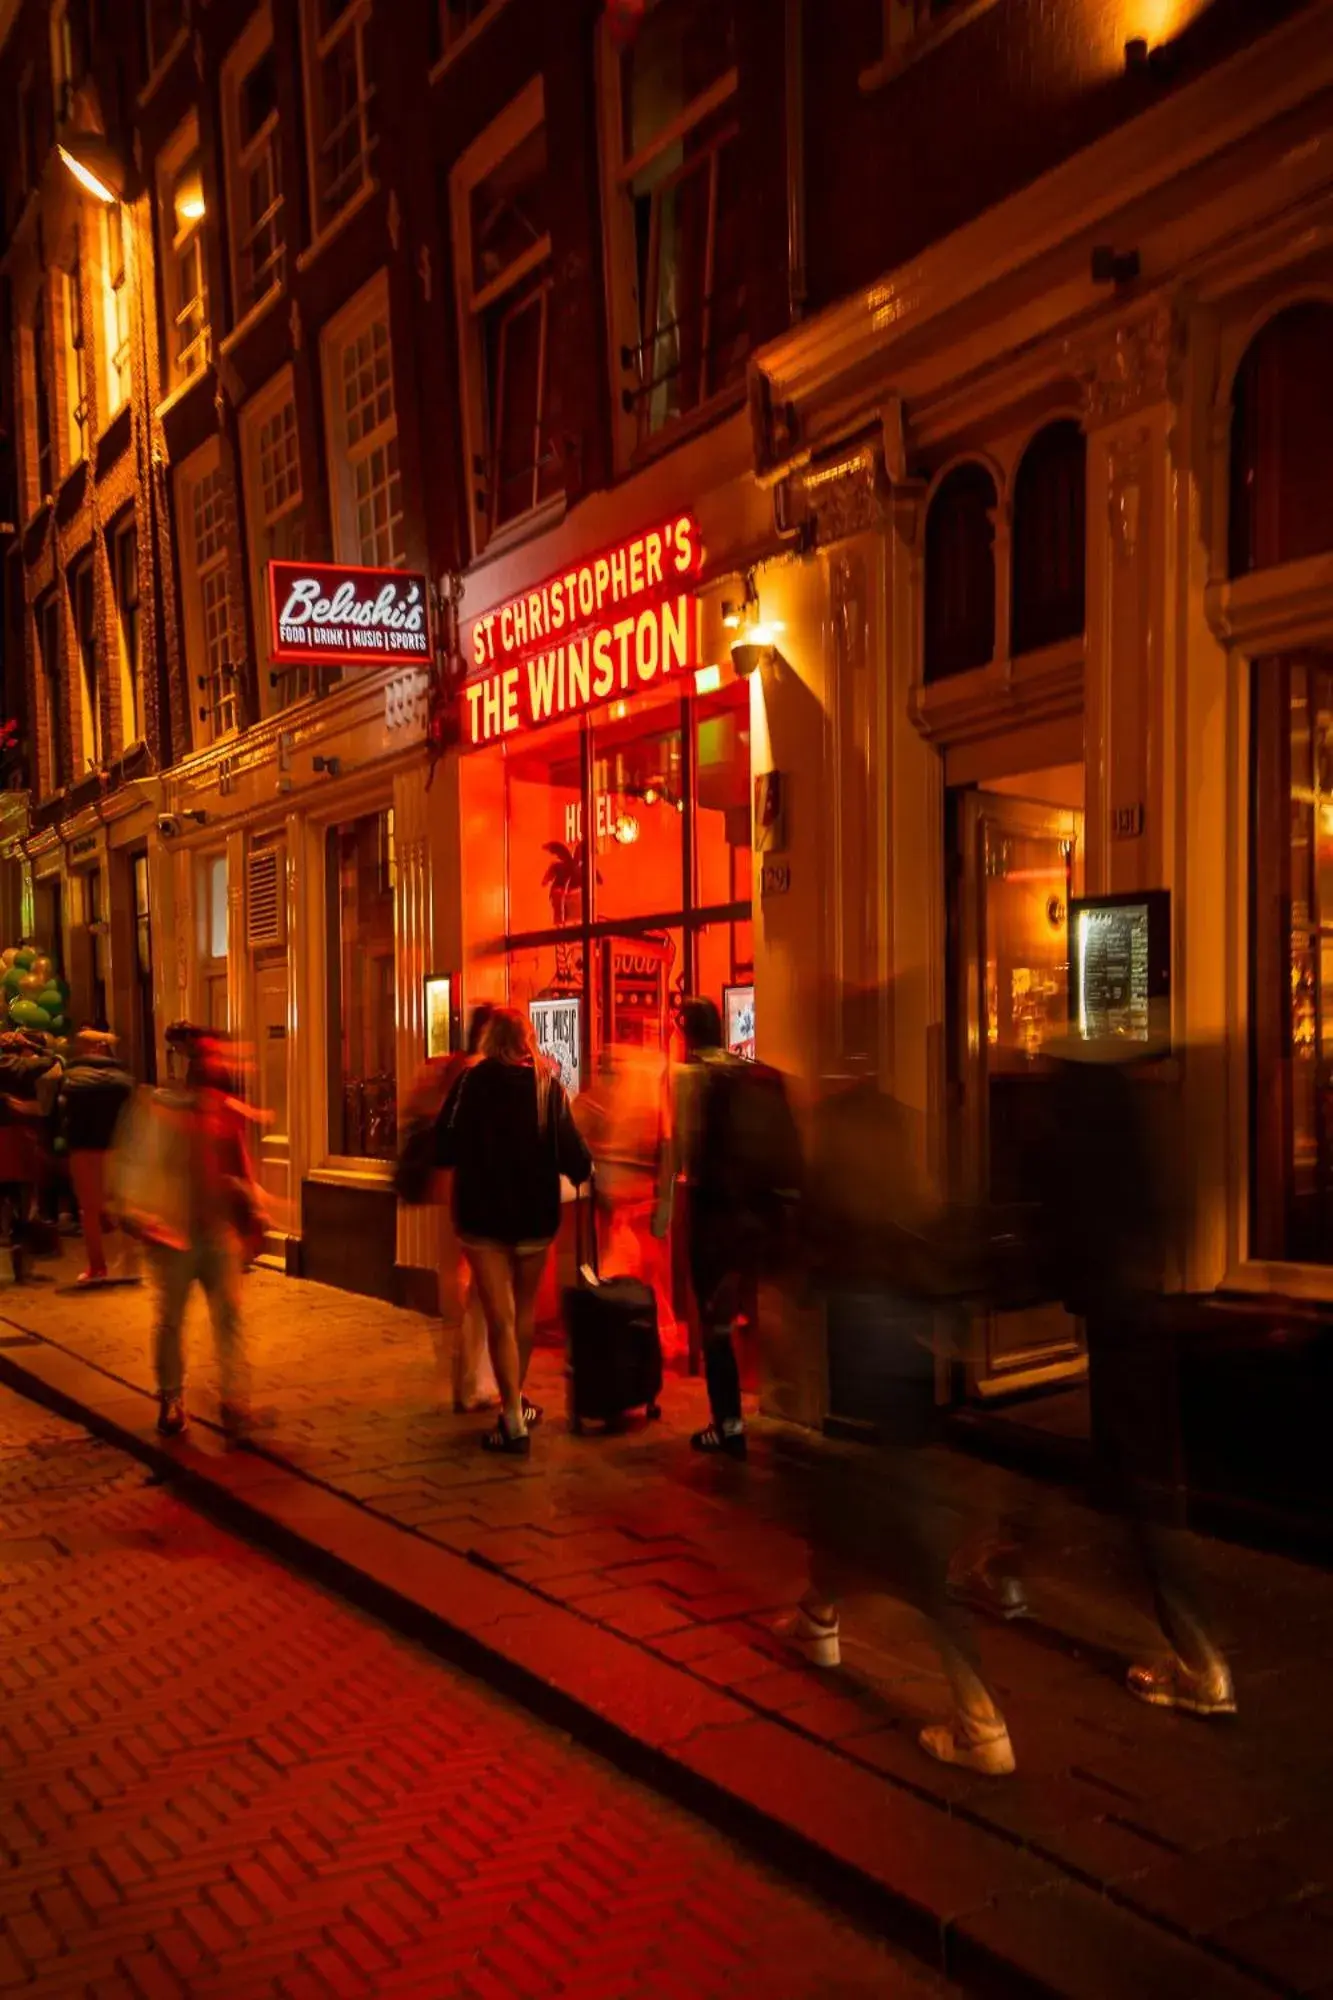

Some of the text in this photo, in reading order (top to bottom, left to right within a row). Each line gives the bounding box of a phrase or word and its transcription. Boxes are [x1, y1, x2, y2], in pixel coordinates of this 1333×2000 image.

[279, 578, 424, 631] Belushi's
[472, 517, 692, 665] ST CHRISTOPHER'S
[280, 625, 426, 650] FOOD DRINK MUSIC SPORTS
[466, 667, 519, 744] THE
[527, 594, 688, 722] WINSTON
[565, 794, 616, 844] HOEL
[552, 1008, 578, 1068] MUSIC
